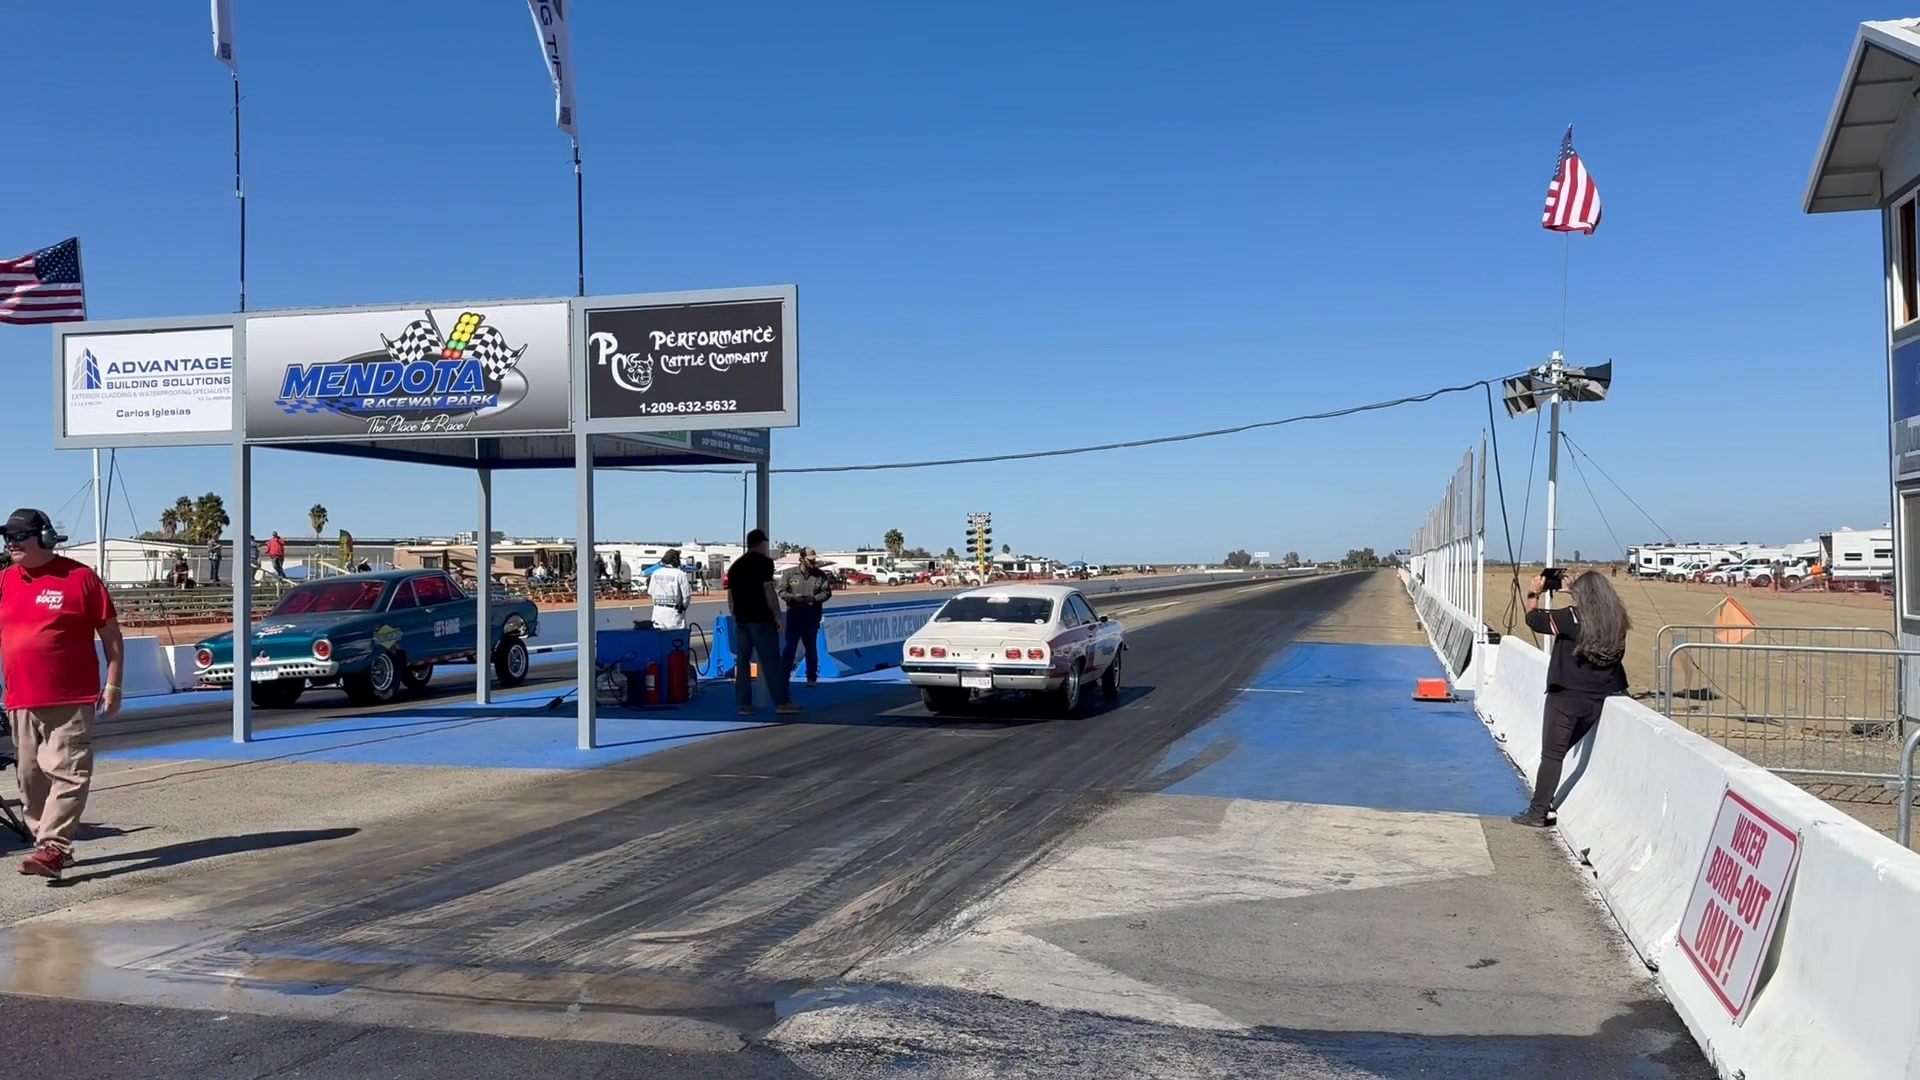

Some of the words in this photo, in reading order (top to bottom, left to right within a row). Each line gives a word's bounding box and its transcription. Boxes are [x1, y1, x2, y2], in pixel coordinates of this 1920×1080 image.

[107, 357, 232, 375] ADVANTAGE
[106, 380, 158, 390] BUILDING
[162, 376, 231, 387] SOLUTIONS
[281, 359, 485, 399] MENDOTA
[362, 396, 442, 409] RACEWAY
[446, 394, 495, 406] PARK
[639, 400, 737, 413] 1-209-632-5632
[116, 409, 150, 418] Carlos
[152, 407, 191, 418] Iglesias
[366, 415, 387, 434] The
[385, 414, 418, 433] Place
[420, 416, 431, 432] to
[431, 413, 474, 432] Race!
[36, 595, 64, 603] ROCKY
[846, 617, 890, 644] MENDOTA
[1731, 813, 1768, 869] WATER
[1705, 845, 1772, 931] BURN-OUT
[1694, 897, 1744, 986] ONLY!
